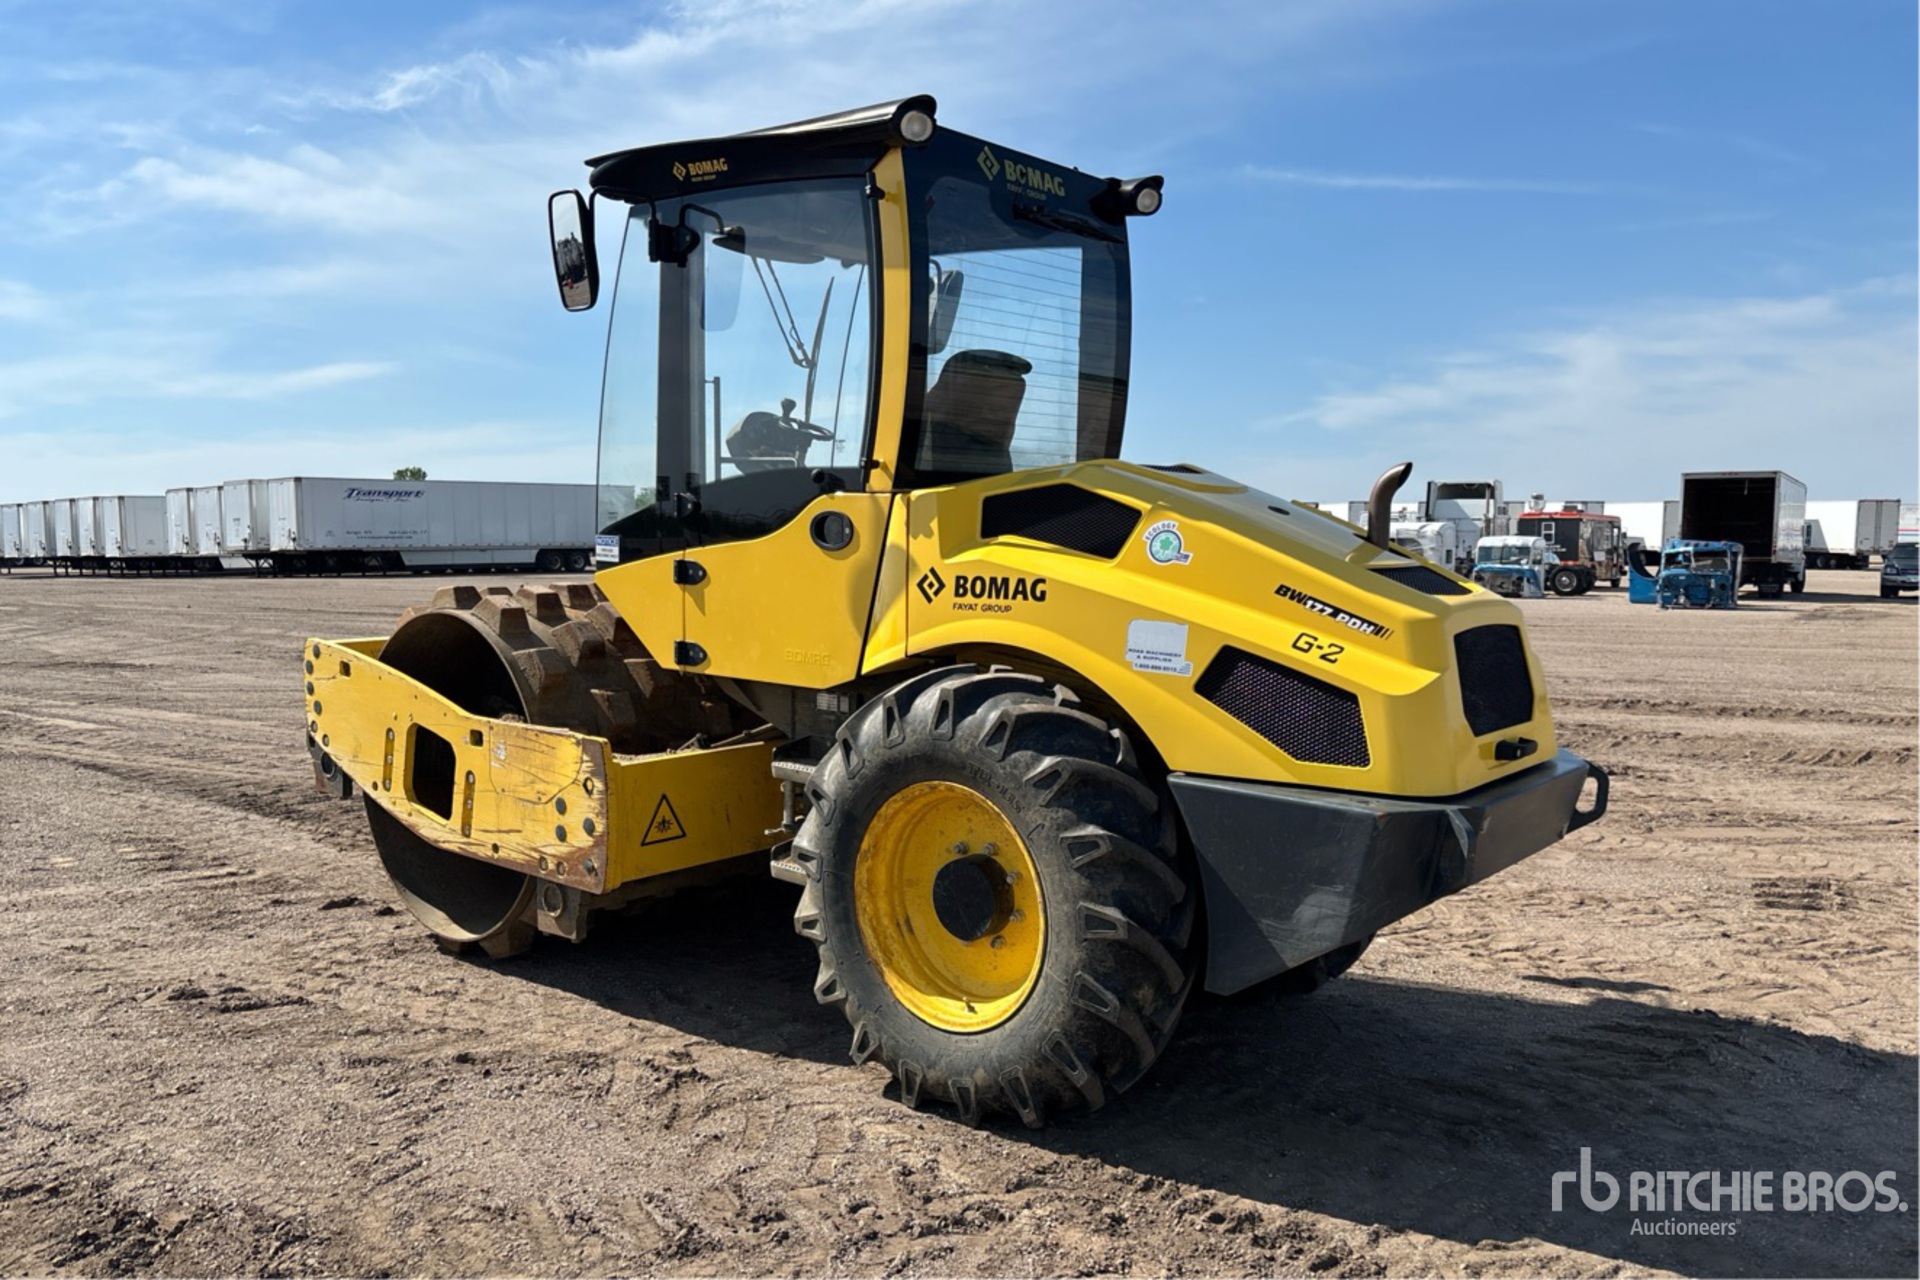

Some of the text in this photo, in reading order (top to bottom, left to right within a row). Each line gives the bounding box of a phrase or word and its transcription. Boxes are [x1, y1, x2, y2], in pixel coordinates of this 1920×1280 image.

[687, 158, 728, 176] BOMAG
[343, 488, 425, 499] Transport
[1145, 522, 1176, 541] ECOLOGY
[953, 575, 1047, 603] BOMAG
[952, 602, 1012, 613] FAYAT GROUP
[1335, 612, 1375, 635] PDH
[1291, 632, 1345, 664] G-2
